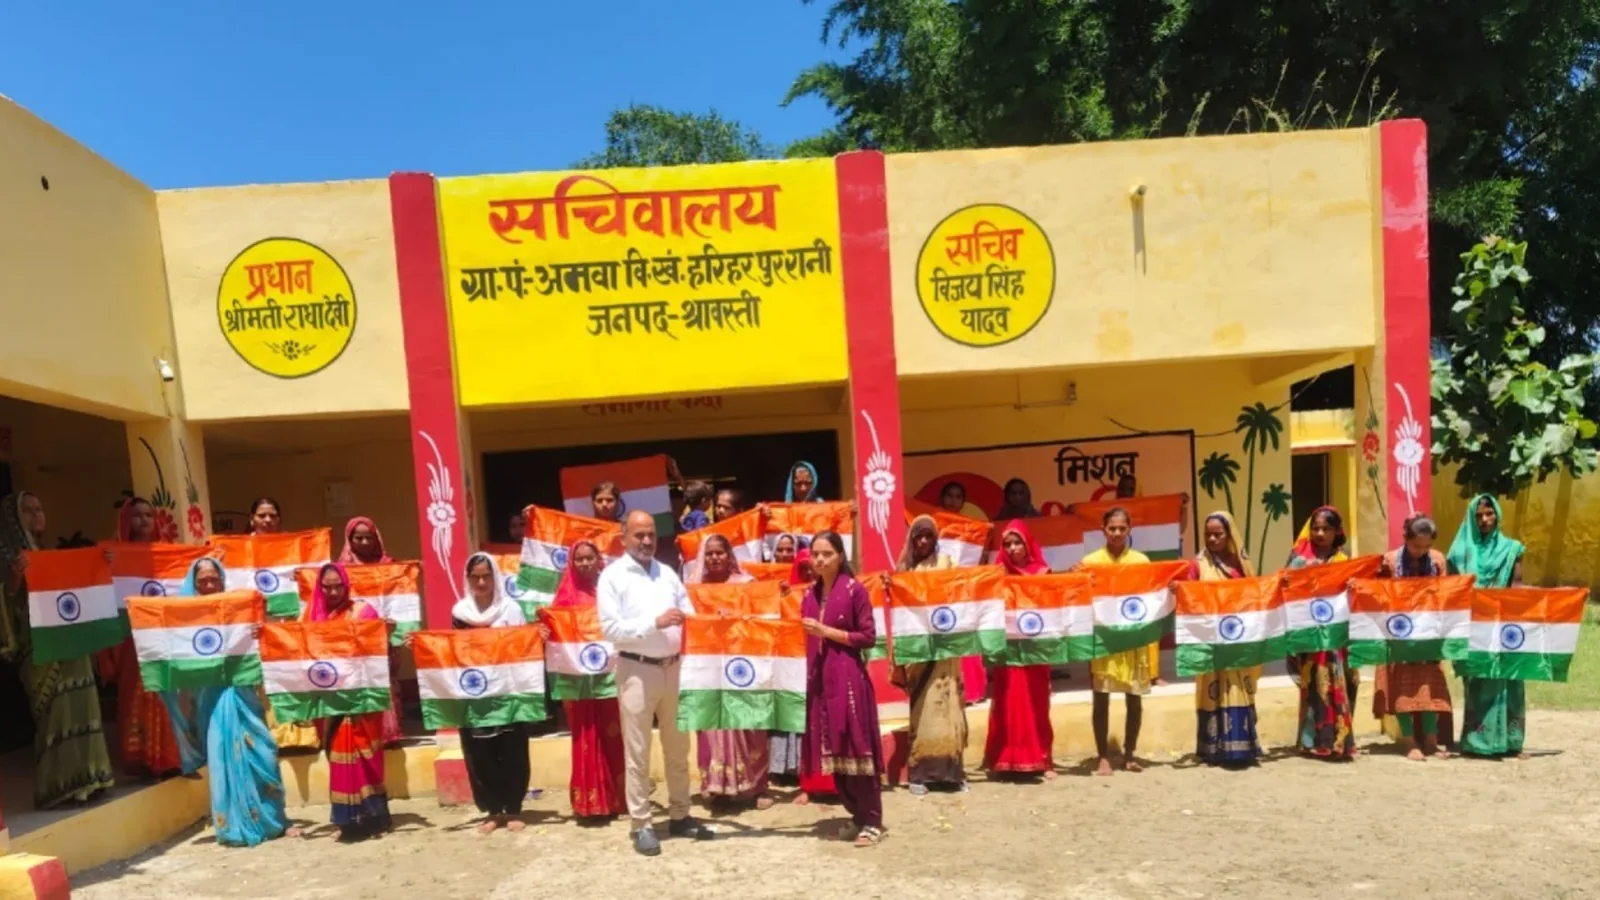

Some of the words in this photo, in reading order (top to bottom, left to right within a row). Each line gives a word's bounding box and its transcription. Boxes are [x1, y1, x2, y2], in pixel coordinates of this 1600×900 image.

[489, 175, 781, 243] सचिवालय
[945, 220, 1024, 266] सचिव
[244, 260, 314, 300] प्रधान
[929, 267, 983, 302] विजय
[984, 264, 1026, 300] सिंह
[225, 298, 283, 332] श्रीमती
[960, 307, 1011, 336] यादव
